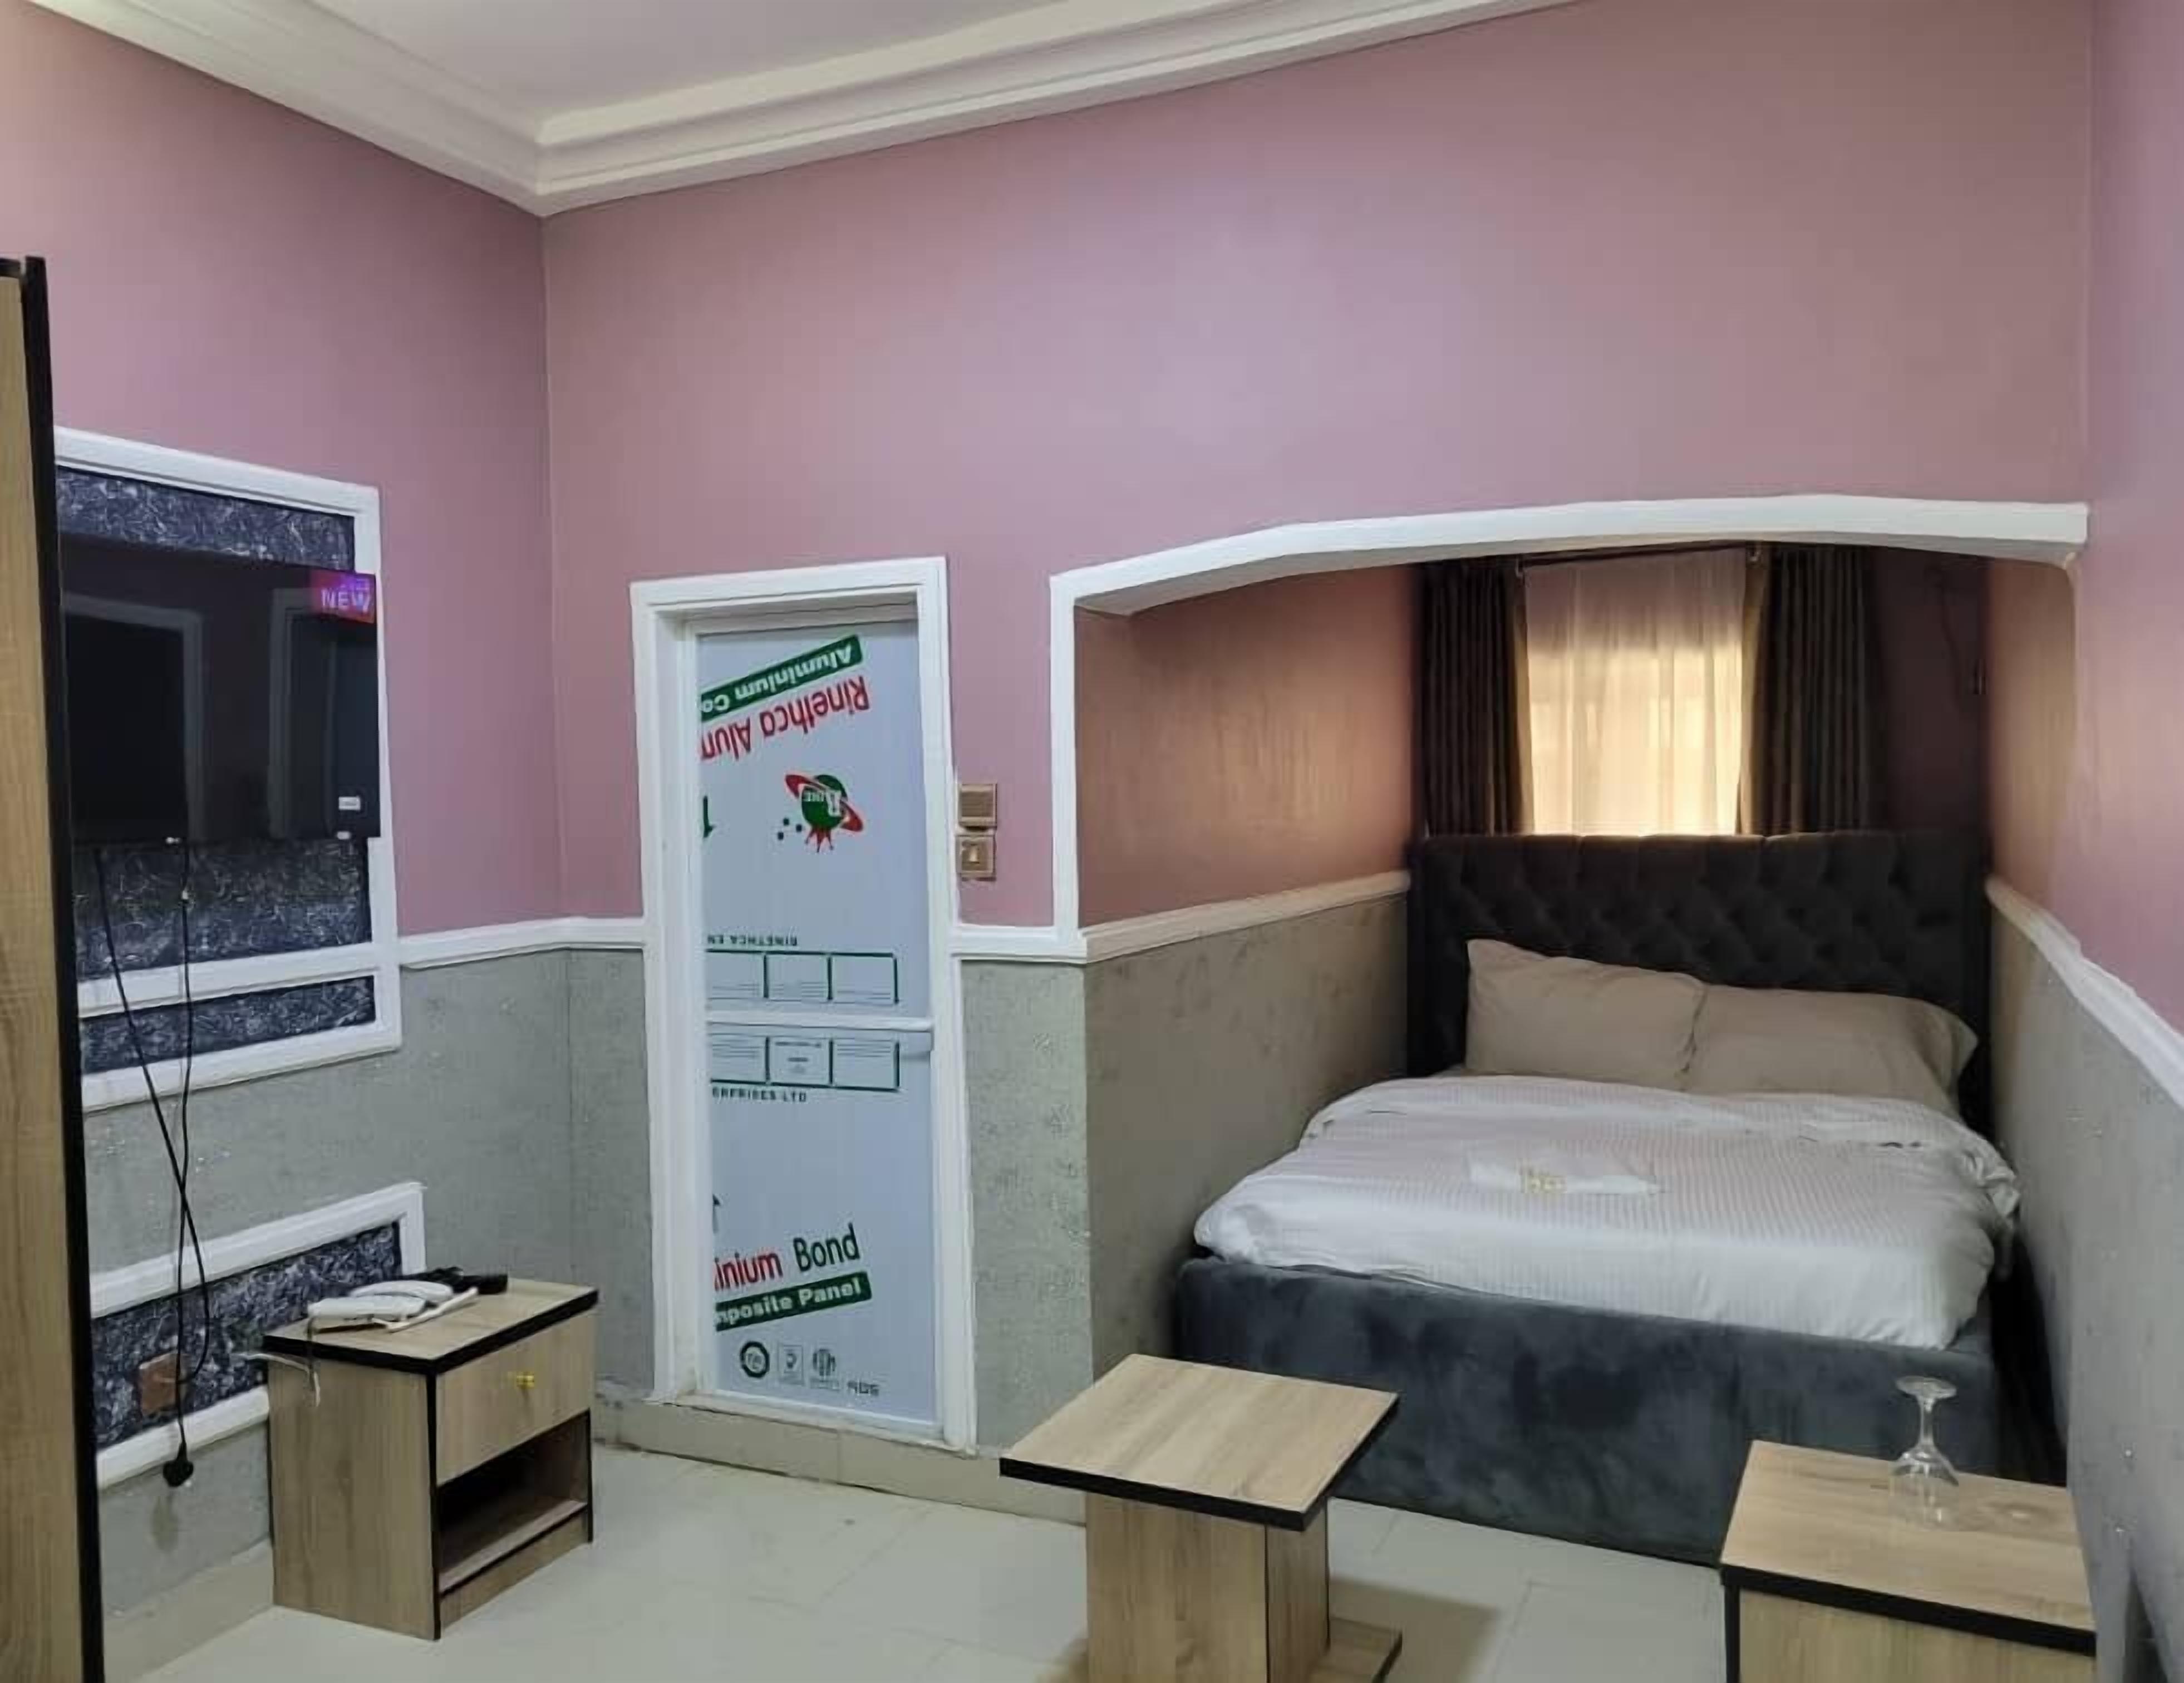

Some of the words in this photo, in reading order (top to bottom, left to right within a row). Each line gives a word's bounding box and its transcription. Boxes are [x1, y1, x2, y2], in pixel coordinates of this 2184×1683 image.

[321, 588, 371, 614] NEW
[735, 643, 853, 700] Aluminium
[715, 1252, 783, 1291] inium
[793, 1222, 860, 1272] Bond
[798, 1277, 861, 1306] Panel
